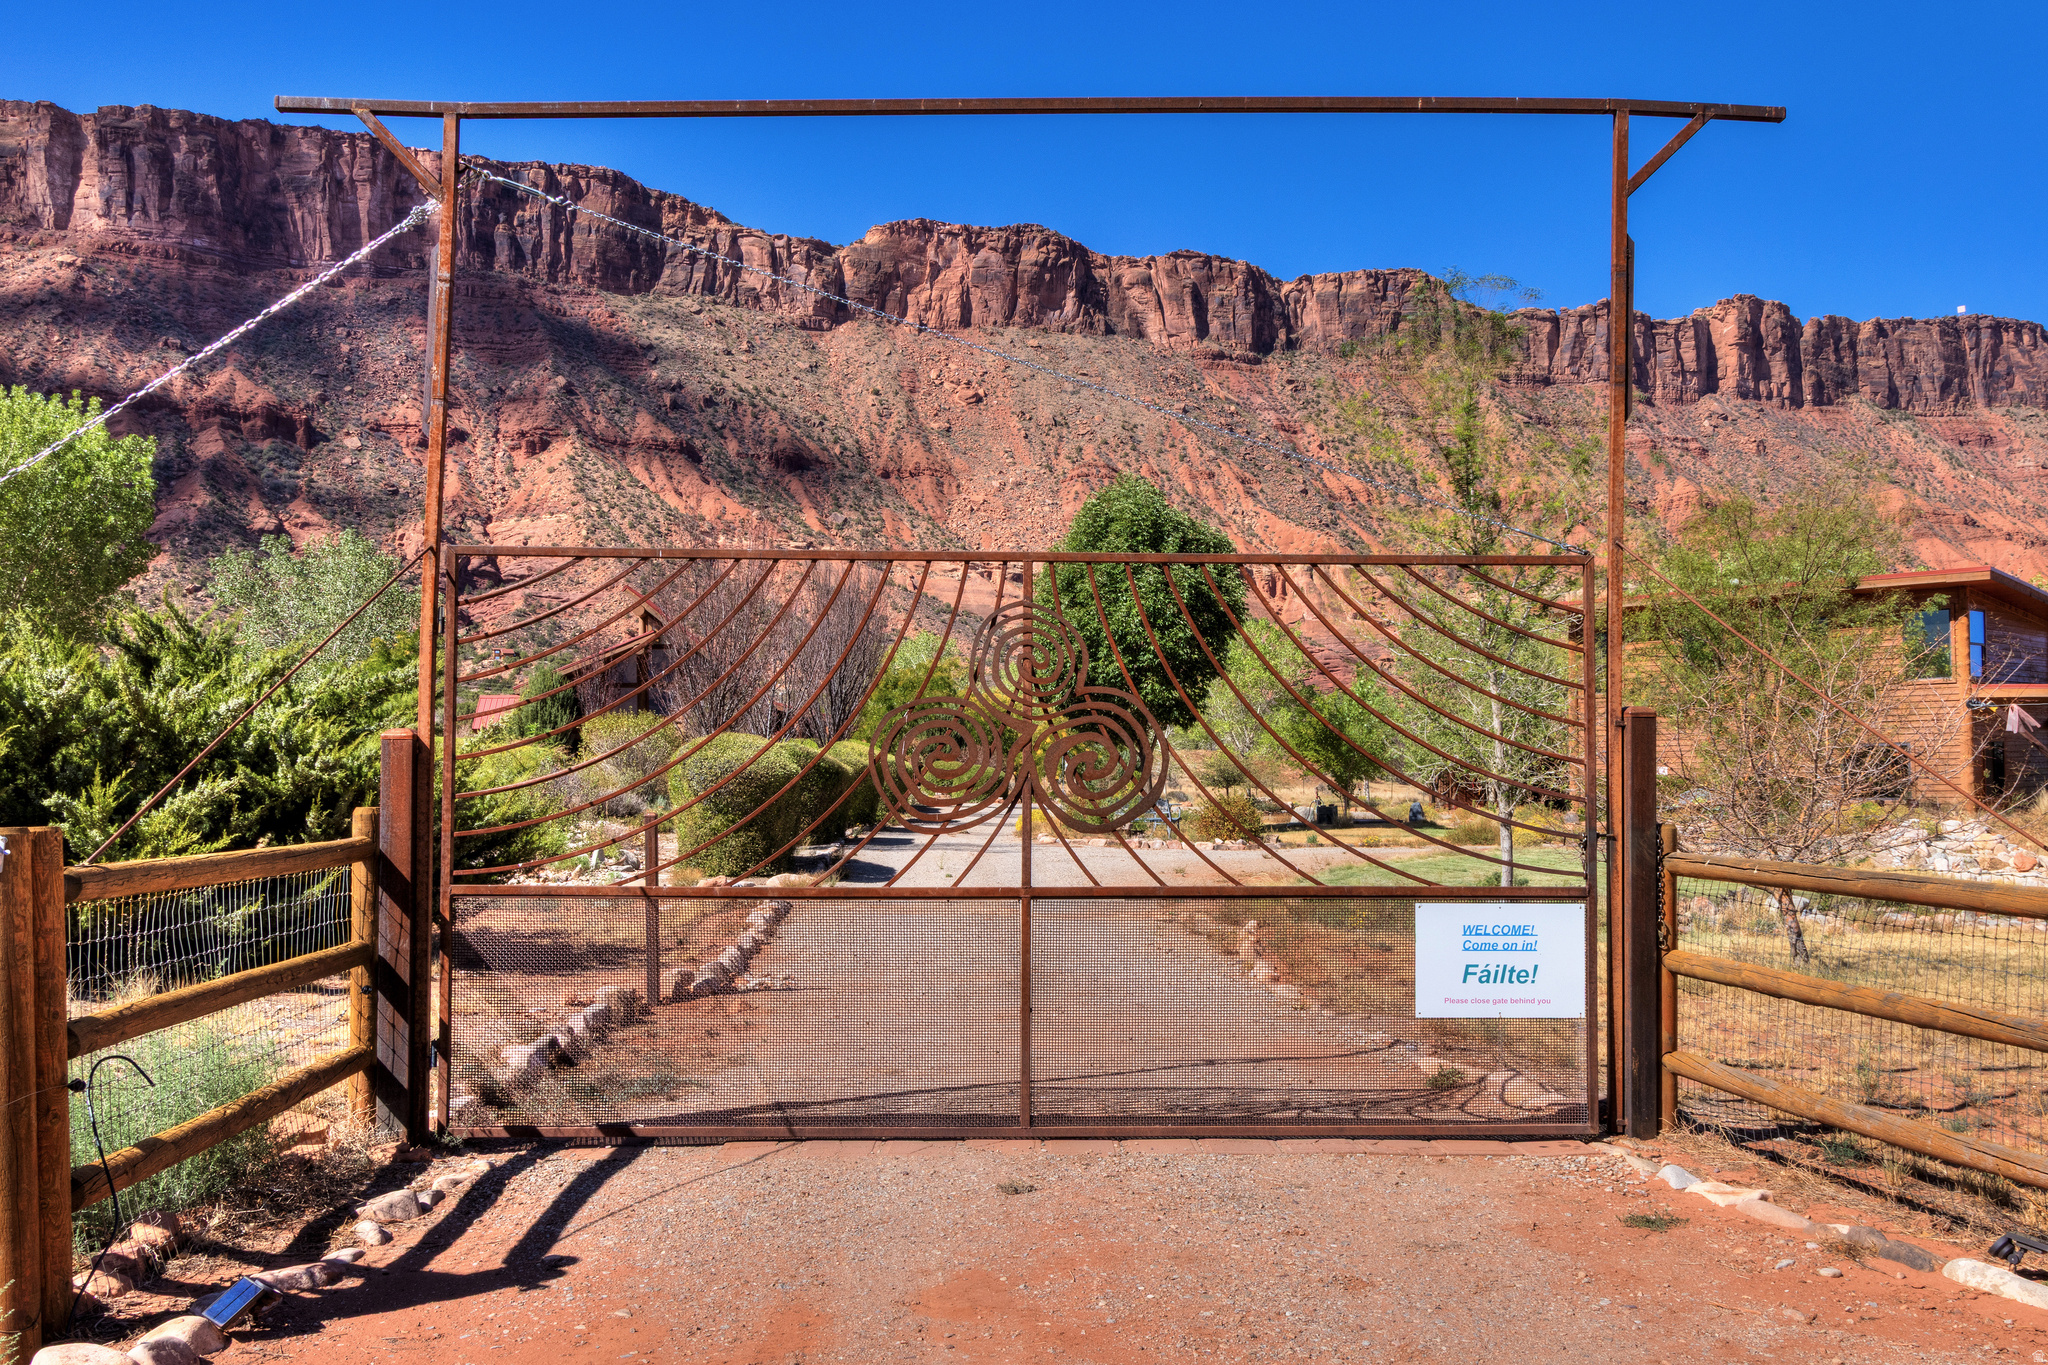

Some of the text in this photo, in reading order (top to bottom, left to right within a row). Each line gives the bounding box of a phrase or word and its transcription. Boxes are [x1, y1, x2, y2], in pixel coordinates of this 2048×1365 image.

[1462, 924, 1536, 936] WELCOME!
[1462, 940, 1538, 951] Come on in!
[1462, 964, 1538, 984] Fáilte!
